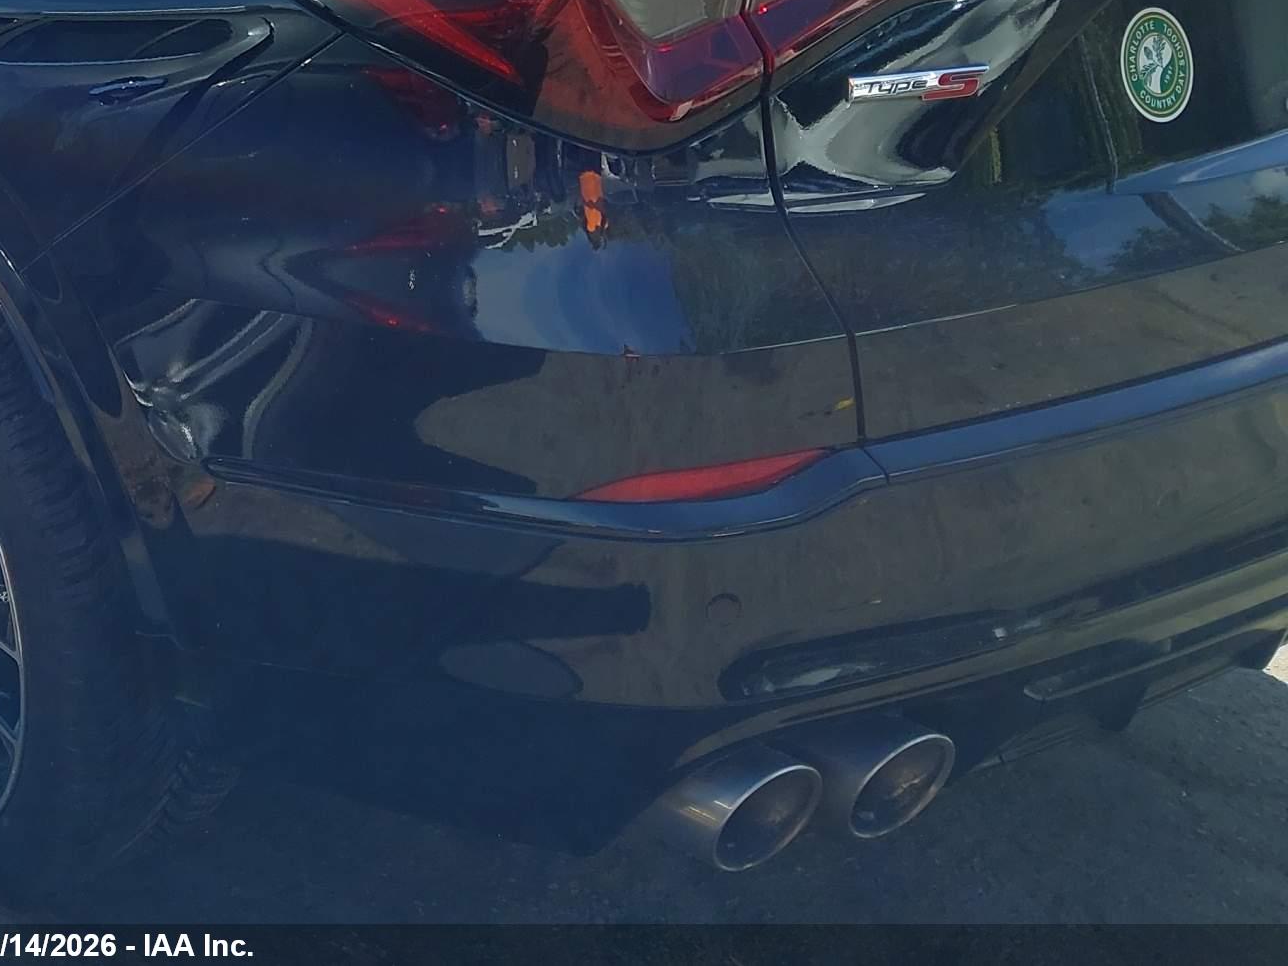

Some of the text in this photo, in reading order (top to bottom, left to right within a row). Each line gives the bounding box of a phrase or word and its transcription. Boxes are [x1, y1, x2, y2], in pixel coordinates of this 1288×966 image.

[1129, 20, 1155, 82] CHARLOTTE
[1140, 23, 1186, 109] COUNTRY DAY SCHOOL
[862, 71, 986, 101] Type S
